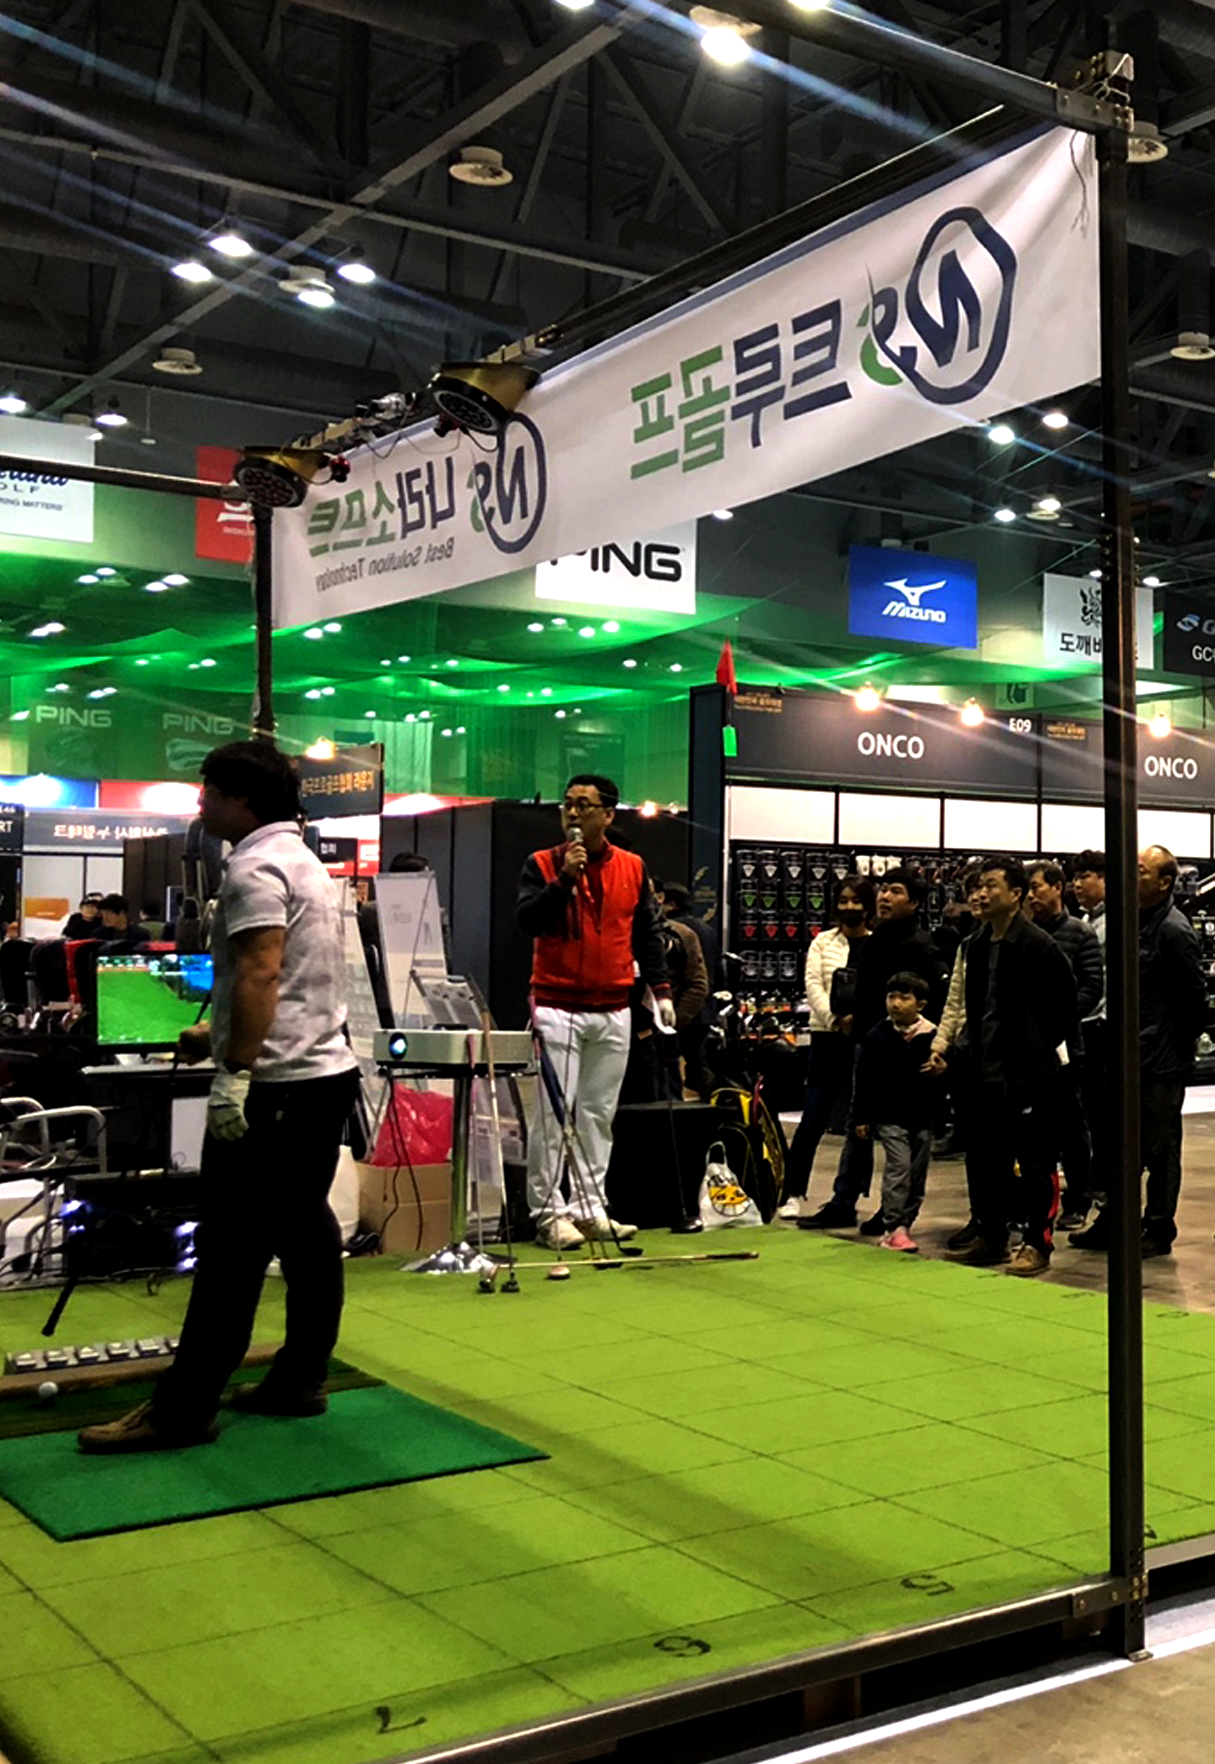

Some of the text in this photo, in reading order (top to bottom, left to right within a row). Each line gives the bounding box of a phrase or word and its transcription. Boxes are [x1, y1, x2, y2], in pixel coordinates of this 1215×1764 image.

[35, 705, 112, 728] PING
[163, 712, 234, 735] PING
[1009, 718, 1032, 733] E09
[857, 732, 925, 759] ONCO
[1144, 755, 1198, 779] ONCO
